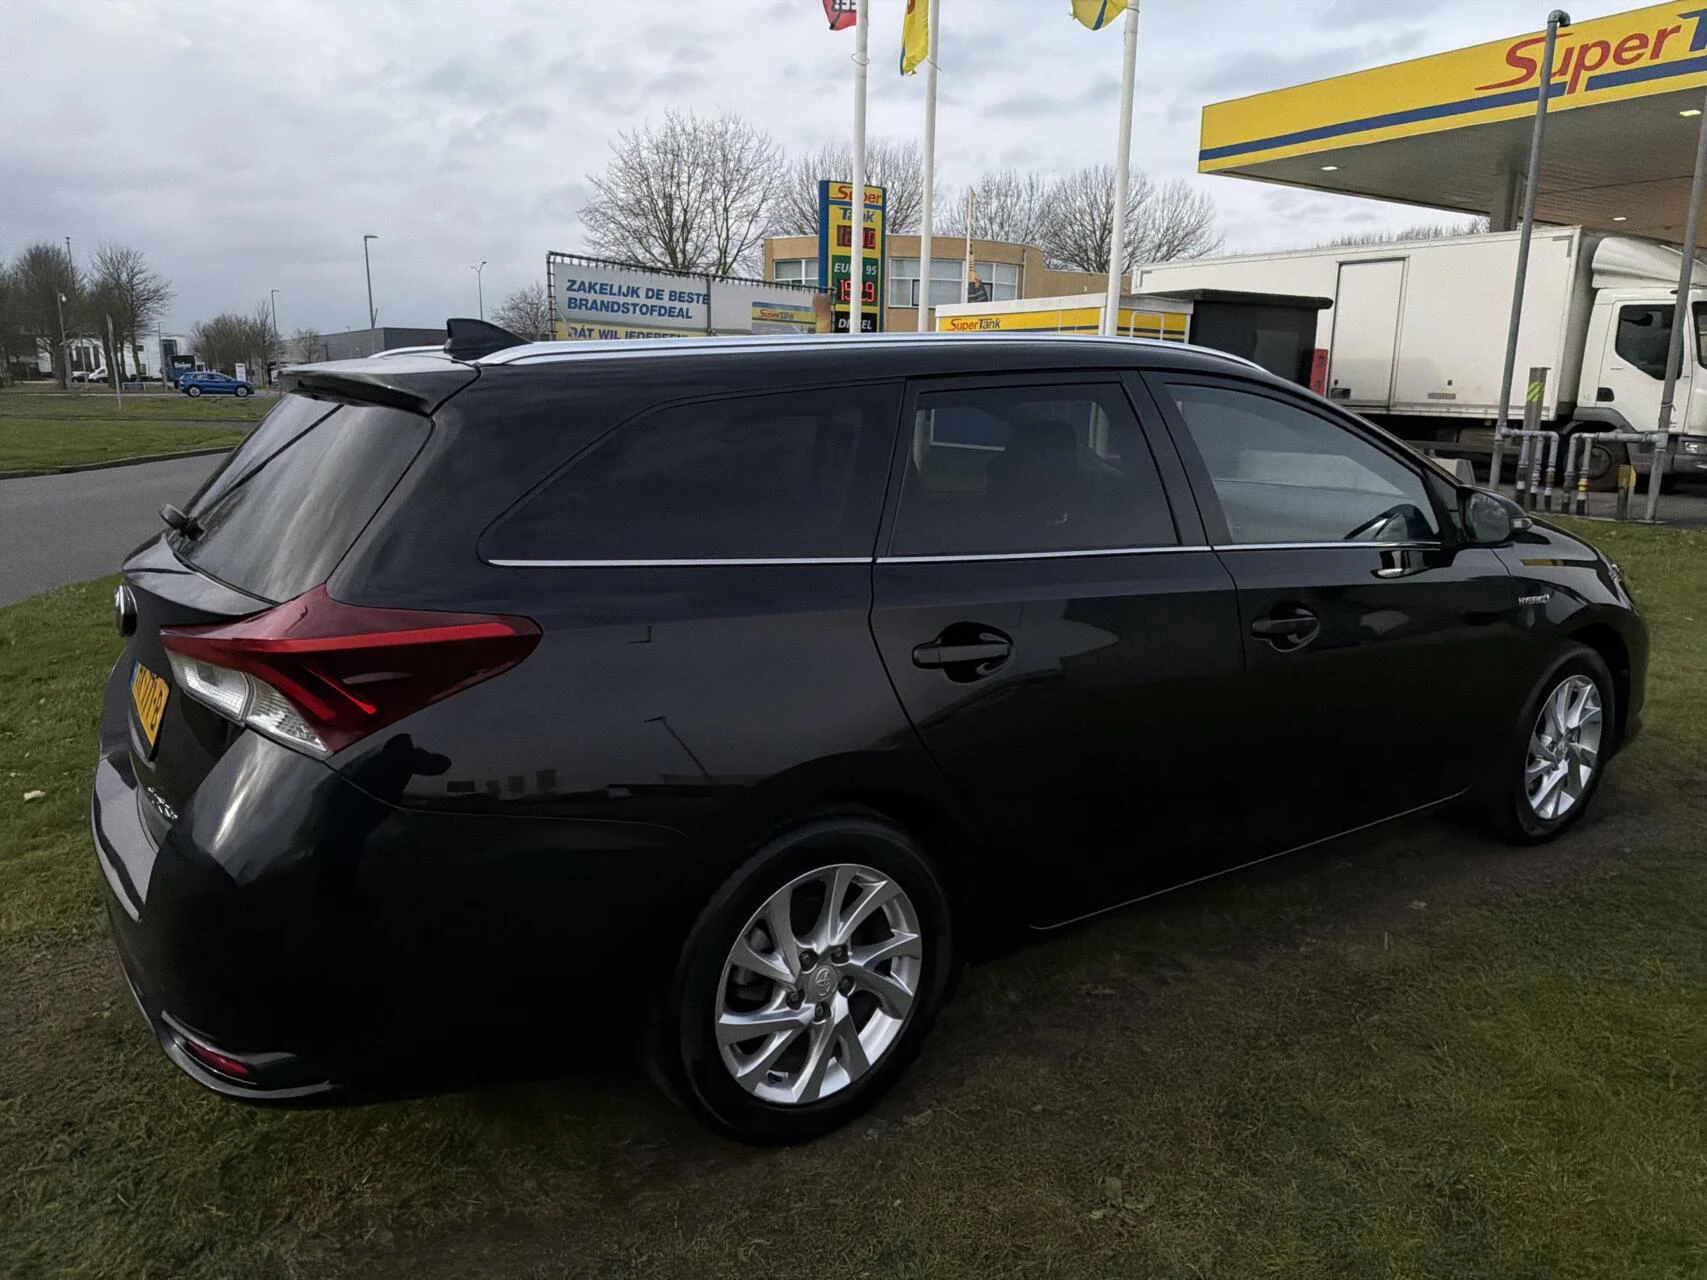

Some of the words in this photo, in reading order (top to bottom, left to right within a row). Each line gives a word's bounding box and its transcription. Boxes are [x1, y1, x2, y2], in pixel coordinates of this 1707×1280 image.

[830, 185, 882, 204] Ser
[839, 206, 875, 223] Tak
[866, 265, 877, 275] 95
[566, 279, 640, 299] ZAKELIJK
[645, 287, 664, 301] DE
[668, 290, 710, 306] BESTE
[567, 297, 693, 319] BRANDSTOFDEAL
[838, 318, 872, 330] DIEL
[944, 318, 1001, 331] SuperTank
[598, 328, 621, 340] WIL
